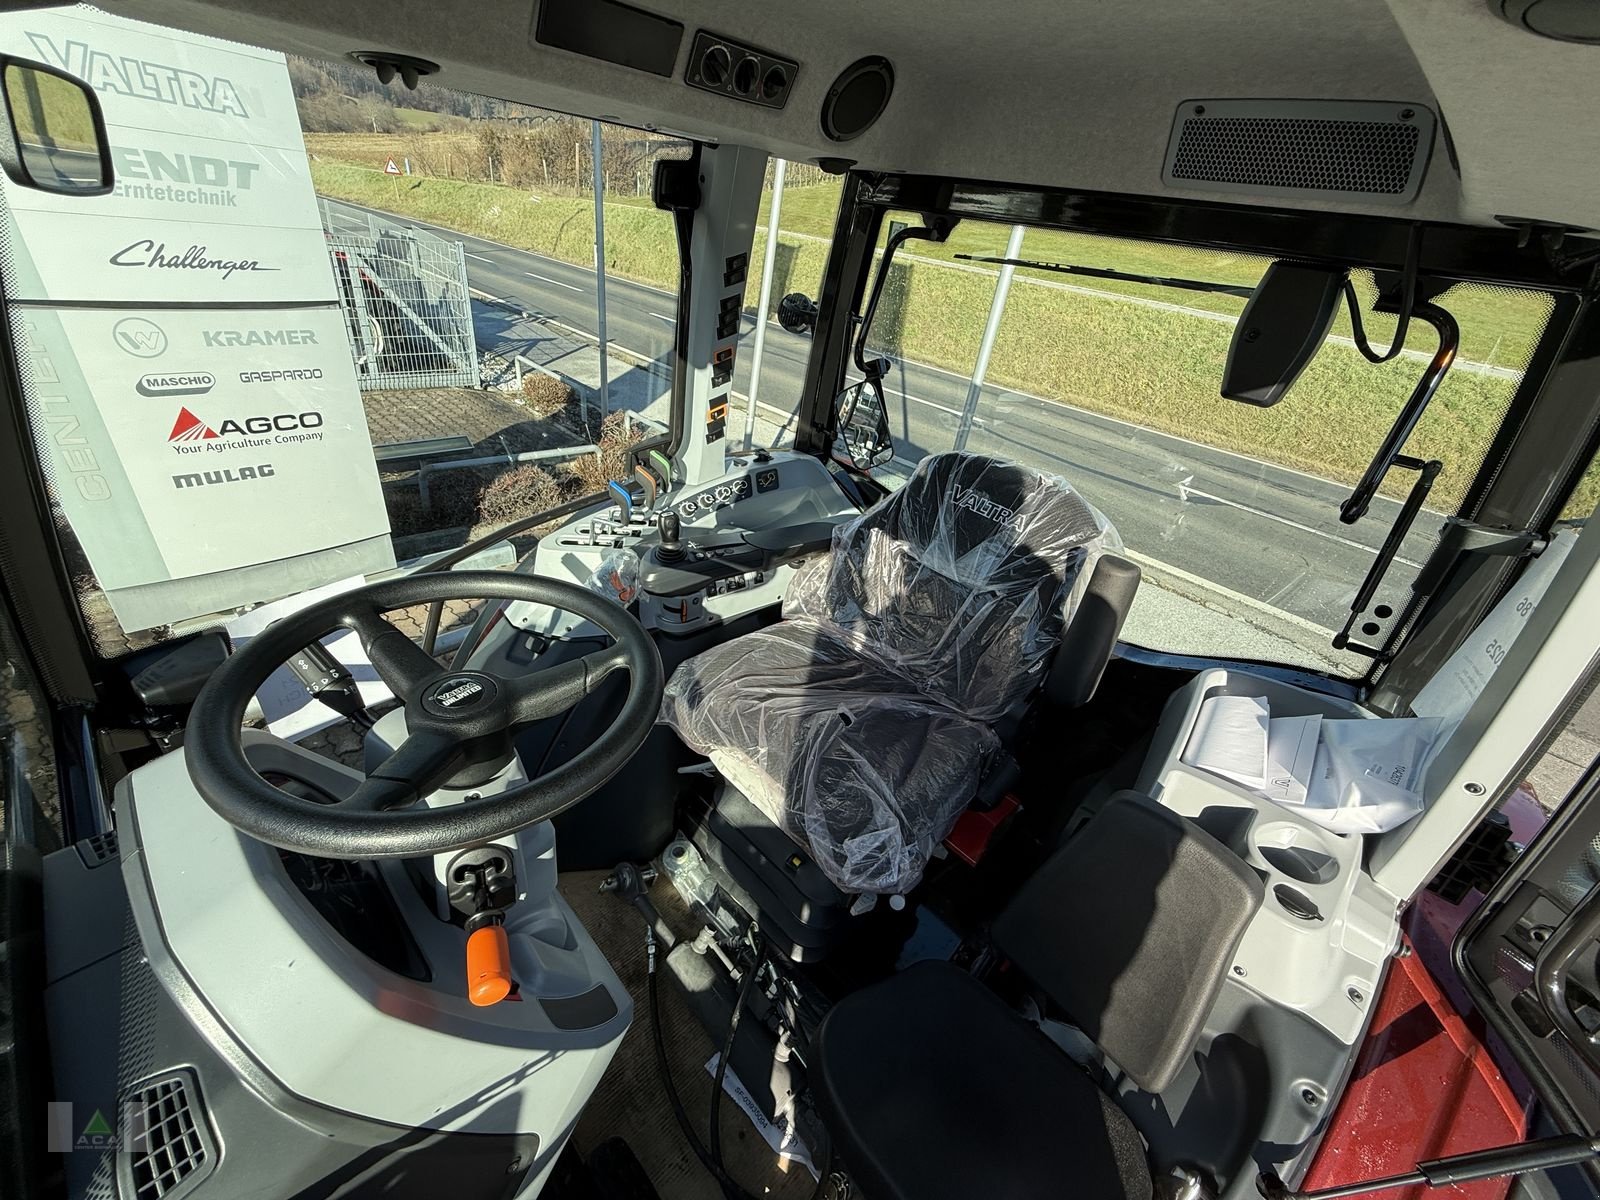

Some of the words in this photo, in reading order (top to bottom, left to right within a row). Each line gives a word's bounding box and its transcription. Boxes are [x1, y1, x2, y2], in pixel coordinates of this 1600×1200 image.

[24, 31, 249, 118] VALTRA
[110, 146, 260, 190] ENDT
[113, 180, 238, 207] Erntetechnik
[108, 239, 281, 280] Challenger
[202, 329, 320, 347] KRAMER
[145, 375, 212, 387] MASCHIO
[239, 368, 324, 384] GASPARDO
[219, 411, 324, 436] AGCO
[172, 444, 202, 455] Your
[206, 438, 272, 454] Agriculture
[274, 432, 324, 445] Company
[172, 464, 275, 489] MULAG
[951, 483, 1027, 533] VALTRA
[441, 685, 483, 706] UNLIMITED
